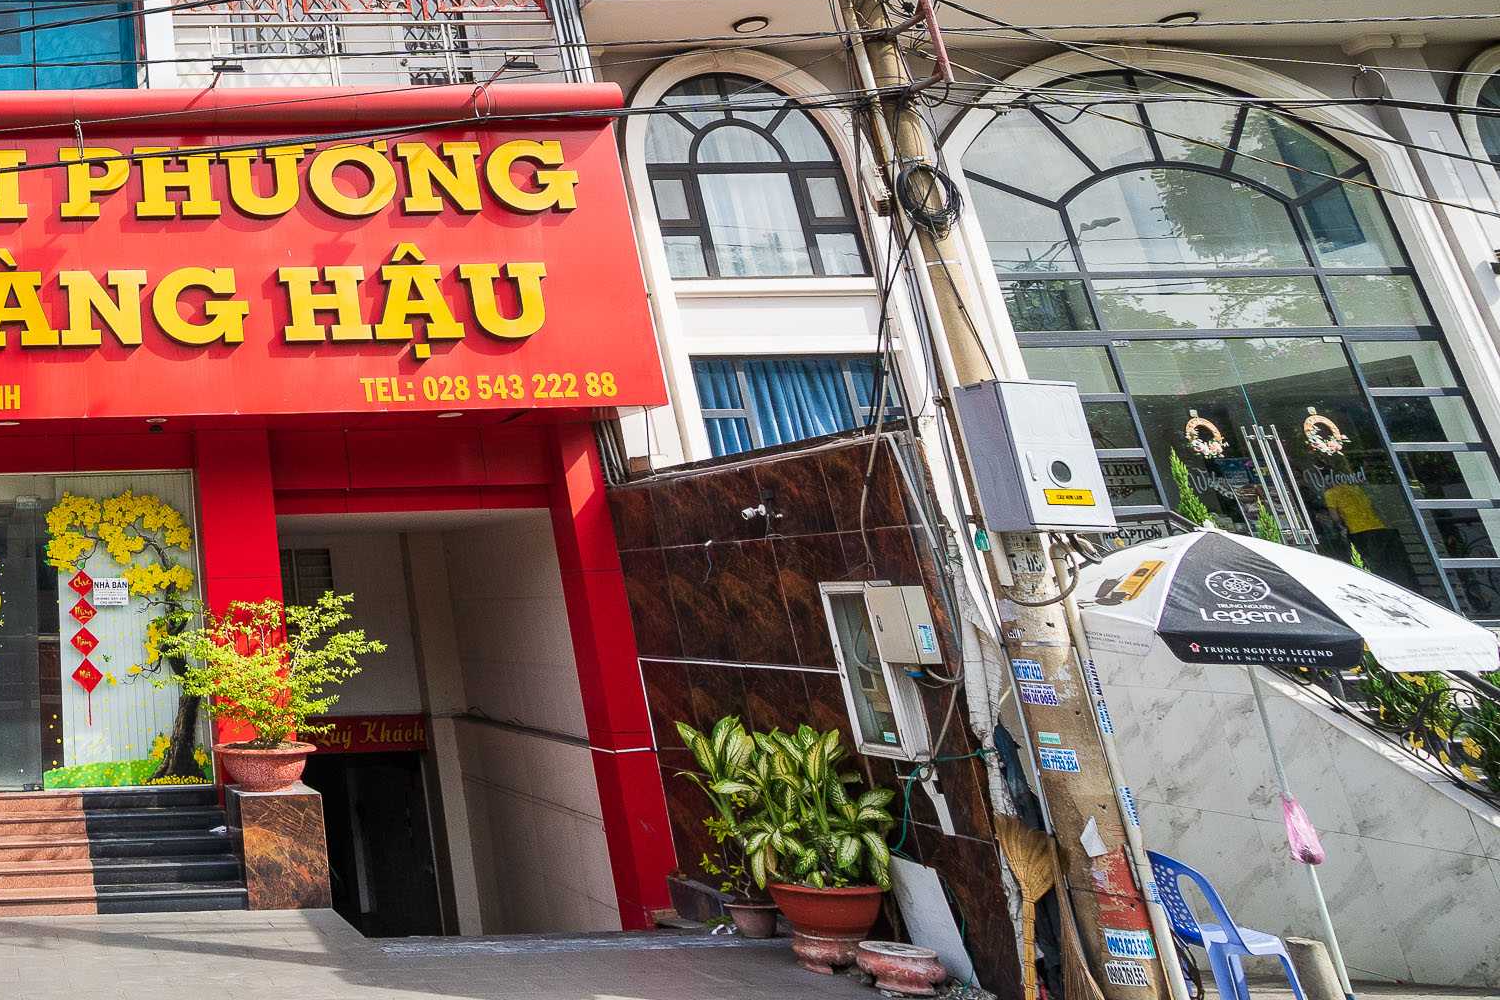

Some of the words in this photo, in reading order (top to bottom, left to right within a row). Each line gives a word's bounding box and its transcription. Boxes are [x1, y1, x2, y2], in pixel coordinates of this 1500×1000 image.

[278, 242, 547, 359] HẬU
[359, 376, 415, 402] TEL:
[422, 375, 471, 401] 028
[476, 374, 525, 400] 543
[531, 373, 579, 398] 222
[584, 371, 618, 397] 88
[1199, 607, 1302, 625] Legend
[1203, 646, 1239, 654] TRUNG
[1290, 649, 1334, 657] LEGEND
[359, 720, 425, 744] Khách
